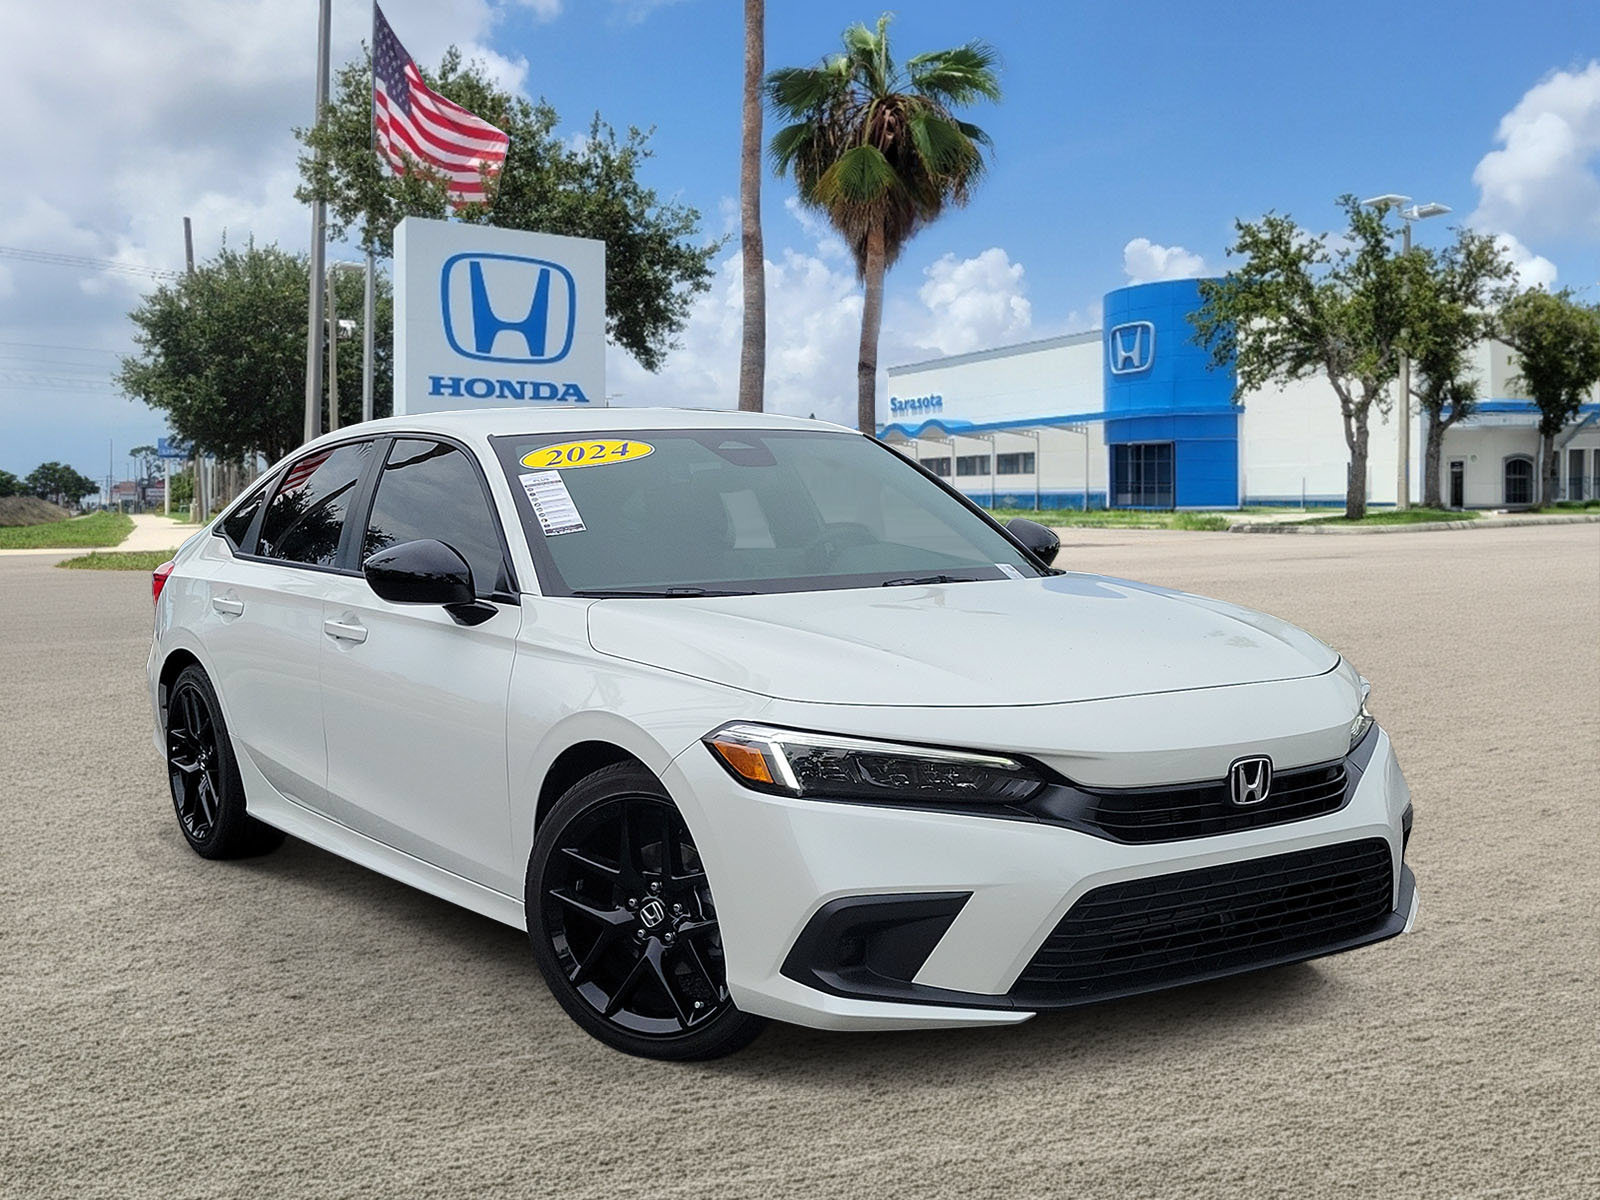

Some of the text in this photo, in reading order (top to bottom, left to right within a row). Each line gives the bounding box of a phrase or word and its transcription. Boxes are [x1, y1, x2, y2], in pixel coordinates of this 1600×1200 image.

[428, 375, 590, 403] HONDA
[890, 393, 943, 412] Sarasota
[545, 442, 630, 466] 2024
